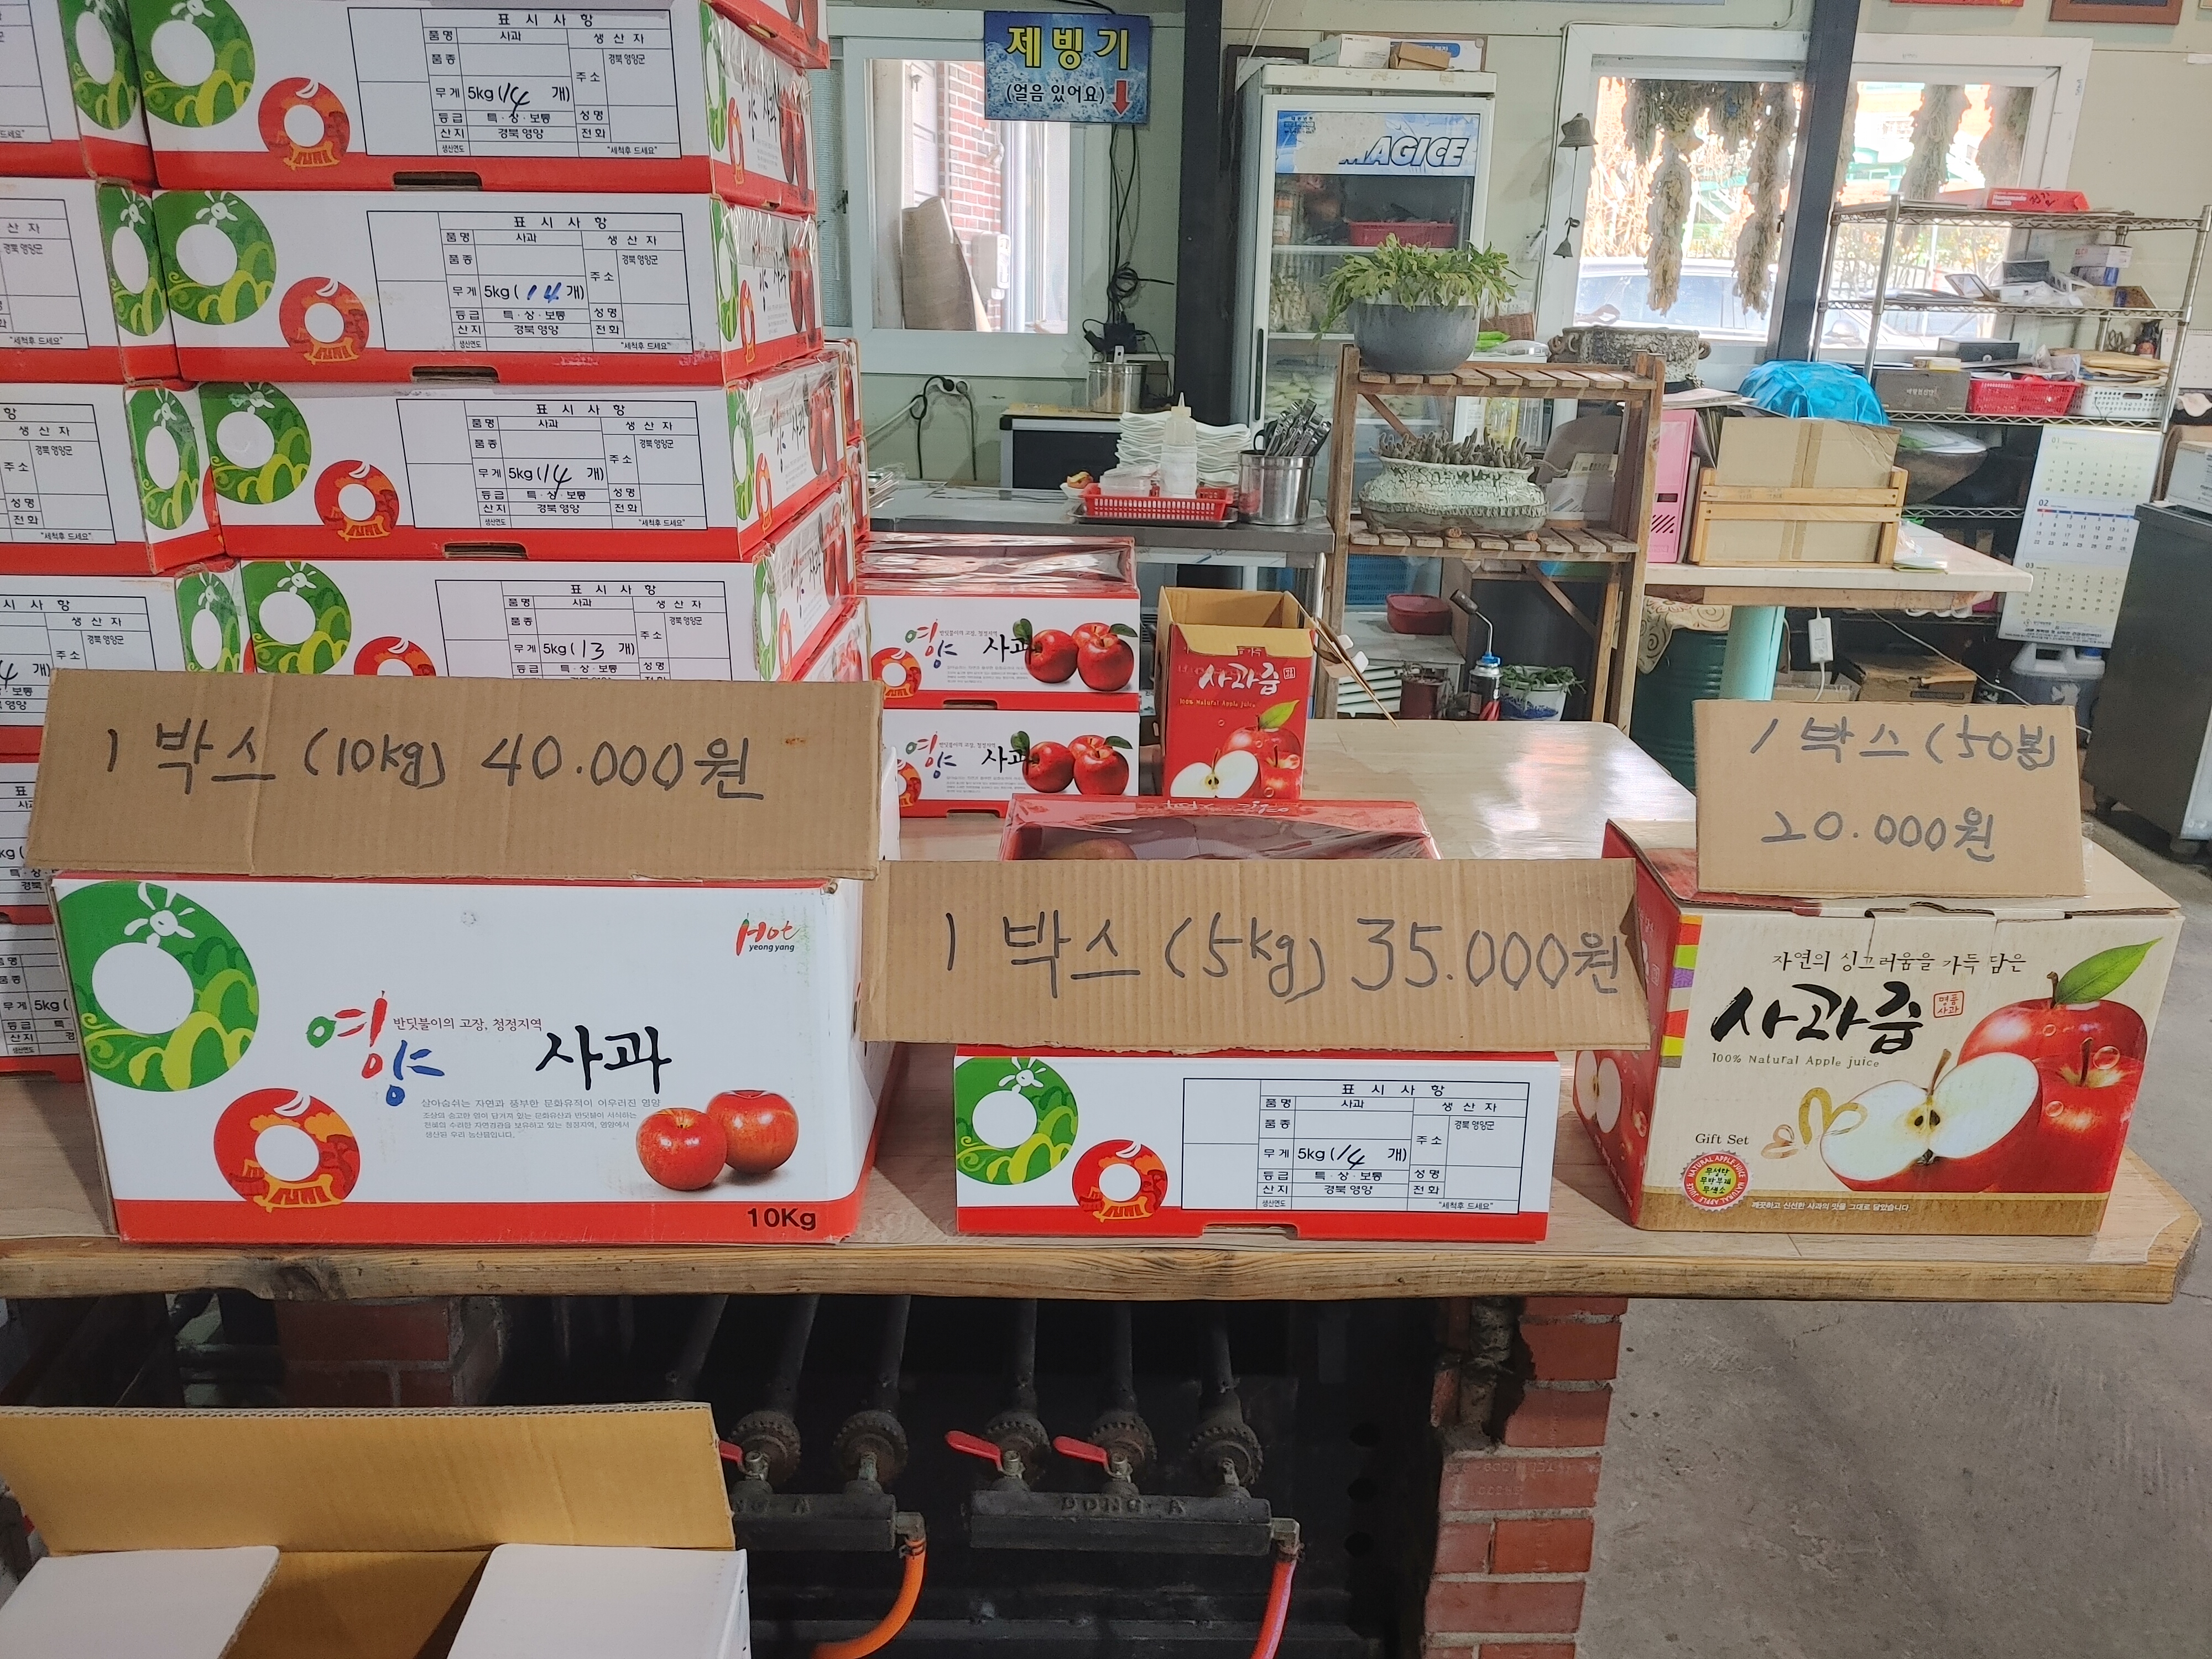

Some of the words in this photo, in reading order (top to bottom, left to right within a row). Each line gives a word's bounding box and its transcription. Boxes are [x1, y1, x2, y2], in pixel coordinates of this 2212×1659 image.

[500, 31, 521, 41] 사과
[1006, 27, 1129, 71] 제빙기
[608, 54, 623, 65] 경북
[624, 54, 645, 65] 영양군
[468, 86, 494, 102] 5kg
[1006, 84, 1044, 104] (얼음
[1051, 85, 1105, 105] 있어요)
[498, 128, 519, 139] 경북
[521, 128, 544, 139] 영양
[516, 233, 537, 243] 사과
[622, 254, 636, 265] 경북
[637, 254, 658, 265] 영양군
[484, 285, 510, 300] 5kg
[538, 419, 559, 429] 사과
[35, 446, 50, 455] 경북
[51, 446, 73, 456] 영양군
[639, 439, 653, 449] 경북
[654, 439, 674, 449] 영양군
[508, 467, 533, 481] 5kg
[87, 635, 102, 644] 경북
[103, 635, 124, 645] 영양군
[543, 643, 567, 656] 5kg
[1198, 662, 1281, 696] 사과즙
[1801, 715, 1908, 764] 박스
[107, 729, 118, 773] 1
[156, 718, 276, 795] 박스
[304, 727, 446, 790] (10kg)
[481, 733, 764, 801] 40.000원
[736, 912, 801, 956] Hot
[946, 912, 956, 971] 1
[1002, 910, 1141, 998] 박스
[1165, 911, 1327, 1004] (5kg)
[1350, 917, 1619, 995] 35.000원
[1772, 949, 1830, 971] 자연의
[1840, 951, 1936, 972] 싱그러움을
[1942, 953, 1981, 975] 가득
[1990, 953, 2027, 974] 담은
[393, 1018, 455, 1031] 반딧불이의
[459, 1018, 488, 1031] 고장,
[492, 1018, 542, 1031] 청정지역
[1710, 981, 1923, 1055] 사과즙
[535, 1025, 672, 1094] 사과
[1712, 1052, 1742, 1063] 100%
[1749, 1055, 1799, 1065] Natural
[1805, 1056, 1841, 1067] Apple
[1846, 1057, 1880, 1069] juice
[421, 1099, 470, 1108] 살아숨쉬는
[476, 1099, 505, 1108] 자연과
[509, 1099, 539, 1108] 풍부한
[544, 1099, 592, 1108] 문화유적이
[641, 1099, 661, 1107] 영양
[1340, 1099, 1365, 1109] 사과
[1454, 1120, 1470, 1130] 경북
[1472, 1120, 1495, 1131] 영양군
[1695, 1134, 1721, 1144] Gift
[1727, 1135, 1749, 1145] Set
[1297, 1147, 1325, 1161] 5kg
[1688, 1156, 1714, 1178] NATURAL
[1714, 1155, 1735, 1165] APPLE
[1734, 1162, 1746, 1178] JUICE
[1324, 1185, 1346, 1194] 경북
[1350, 1185, 1373, 1195] 영양
[1720, 1182, 1745, 1203] NATURAL
[1783, 1202, 1806, 1210] 신선한
[1807, 1202, 1829, 1211] 사과의
[746, 1207, 817, 1232] 10Kg
